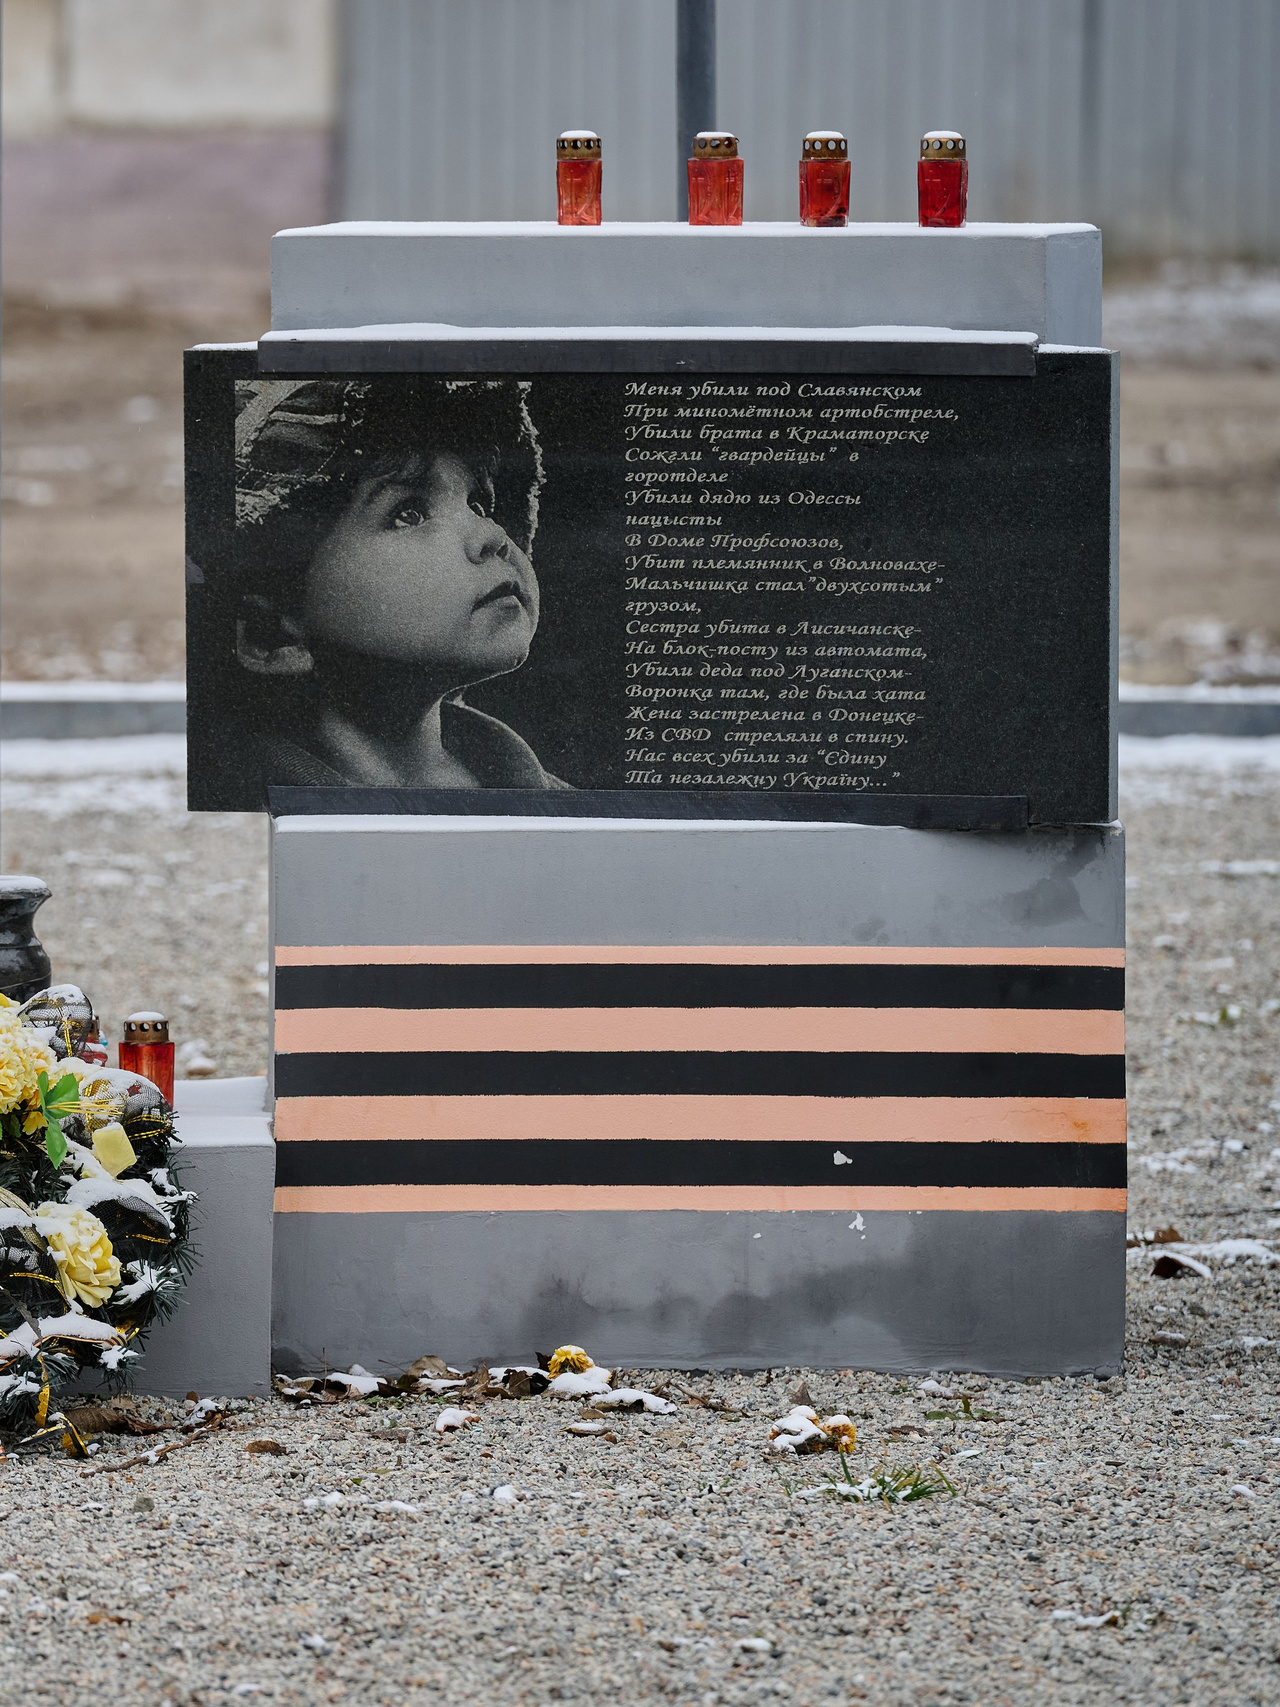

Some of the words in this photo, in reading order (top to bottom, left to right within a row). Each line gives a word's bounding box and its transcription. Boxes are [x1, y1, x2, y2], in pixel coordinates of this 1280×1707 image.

[624, 382, 682, 396] Меня
[686, 380, 749, 401] убили
[756, 381, 791, 396] под
[797, 383, 922, 400] Славянском
[624, 403, 668, 422] При
[674, 405, 813, 418] миномётном
[819, 403, 959, 423] артобстреле,
[624, 423, 692, 441] Убили
[699, 423, 763, 444] брата
[769, 429, 780, 440] в
[786, 426, 930, 444] Краматорске
[625, 447, 702, 464] Сожгли
[849, 452, 859, 462] в
[624, 467, 729, 487] горотделе
[624, 488, 692, 506] Убили
[699, 489, 751, 504] дядю
[758, 494, 781, 505] из
[788, 490, 861, 505] Одессы
[624, 533, 642, 547] В
[647, 533, 705, 548] Доме
[709, 532, 844, 553] Профсоюзов,
[624, 553, 685, 571] Убит
[692, 559, 812, 574] племянник
[813, 560, 823, 570] в
[624, 576, 749, 594] Мальчишка
[625, 601, 702, 616] грузом,
[625, 619, 700, 638] Сестра
[704, 619, 770, 638] убита
[776, 624, 787, 634] в
[624, 640, 656, 655] На
[785, 646, 808, 656] из
[814, 646, 927, 660] автомата,
[625, 661, 693, 678] Убили
[699, 662, 743, 677] деда
[750, 662, 786, 678] под
[625, 684, 713, 702] Воронка
[720, 688, 770, 701] там,
[778, 684, 809, 699] где
[815, 684, 867, 700] была
[872, 690, 926, 703] хата
[625, 706, 682, 722] Жена
[688, 710, 806, 725] застрелена
[811, 711, 822, 721] в
[624, 726, 655, 741] Из
[661, 727, 712, 743] СВД
[724, 731, 822, 747] стреляли
[827, 732, 839, 743] в
[844, 733, 909, 748] спину.
[624, 747, 667, 762] Нас
[672, 752, 717, 766] всех
[716, 747, 780, 768] убили
[785, 753, 808, 764] за
[669, 774, 777, 790] незалежну
